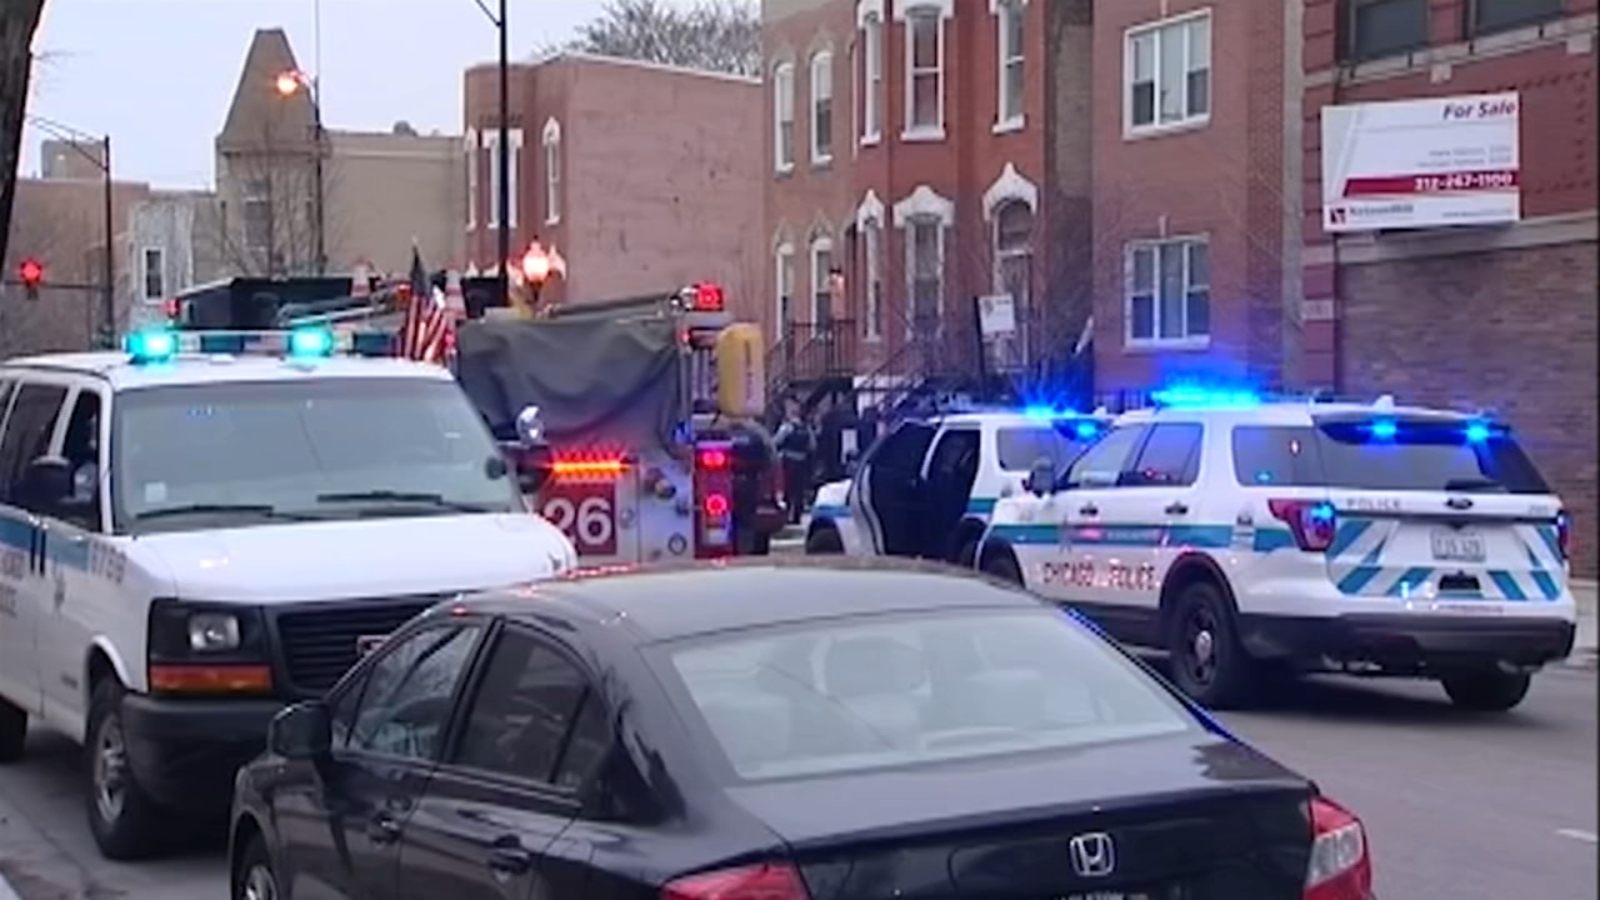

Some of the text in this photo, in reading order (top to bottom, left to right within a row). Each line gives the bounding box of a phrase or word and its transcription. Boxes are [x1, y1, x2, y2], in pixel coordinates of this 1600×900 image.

[1443, 100, 1515, 119] For Sale
[543, 496, 612, 545] 26
[1042, 562, 1156, 590] CHICAGO POLICE
